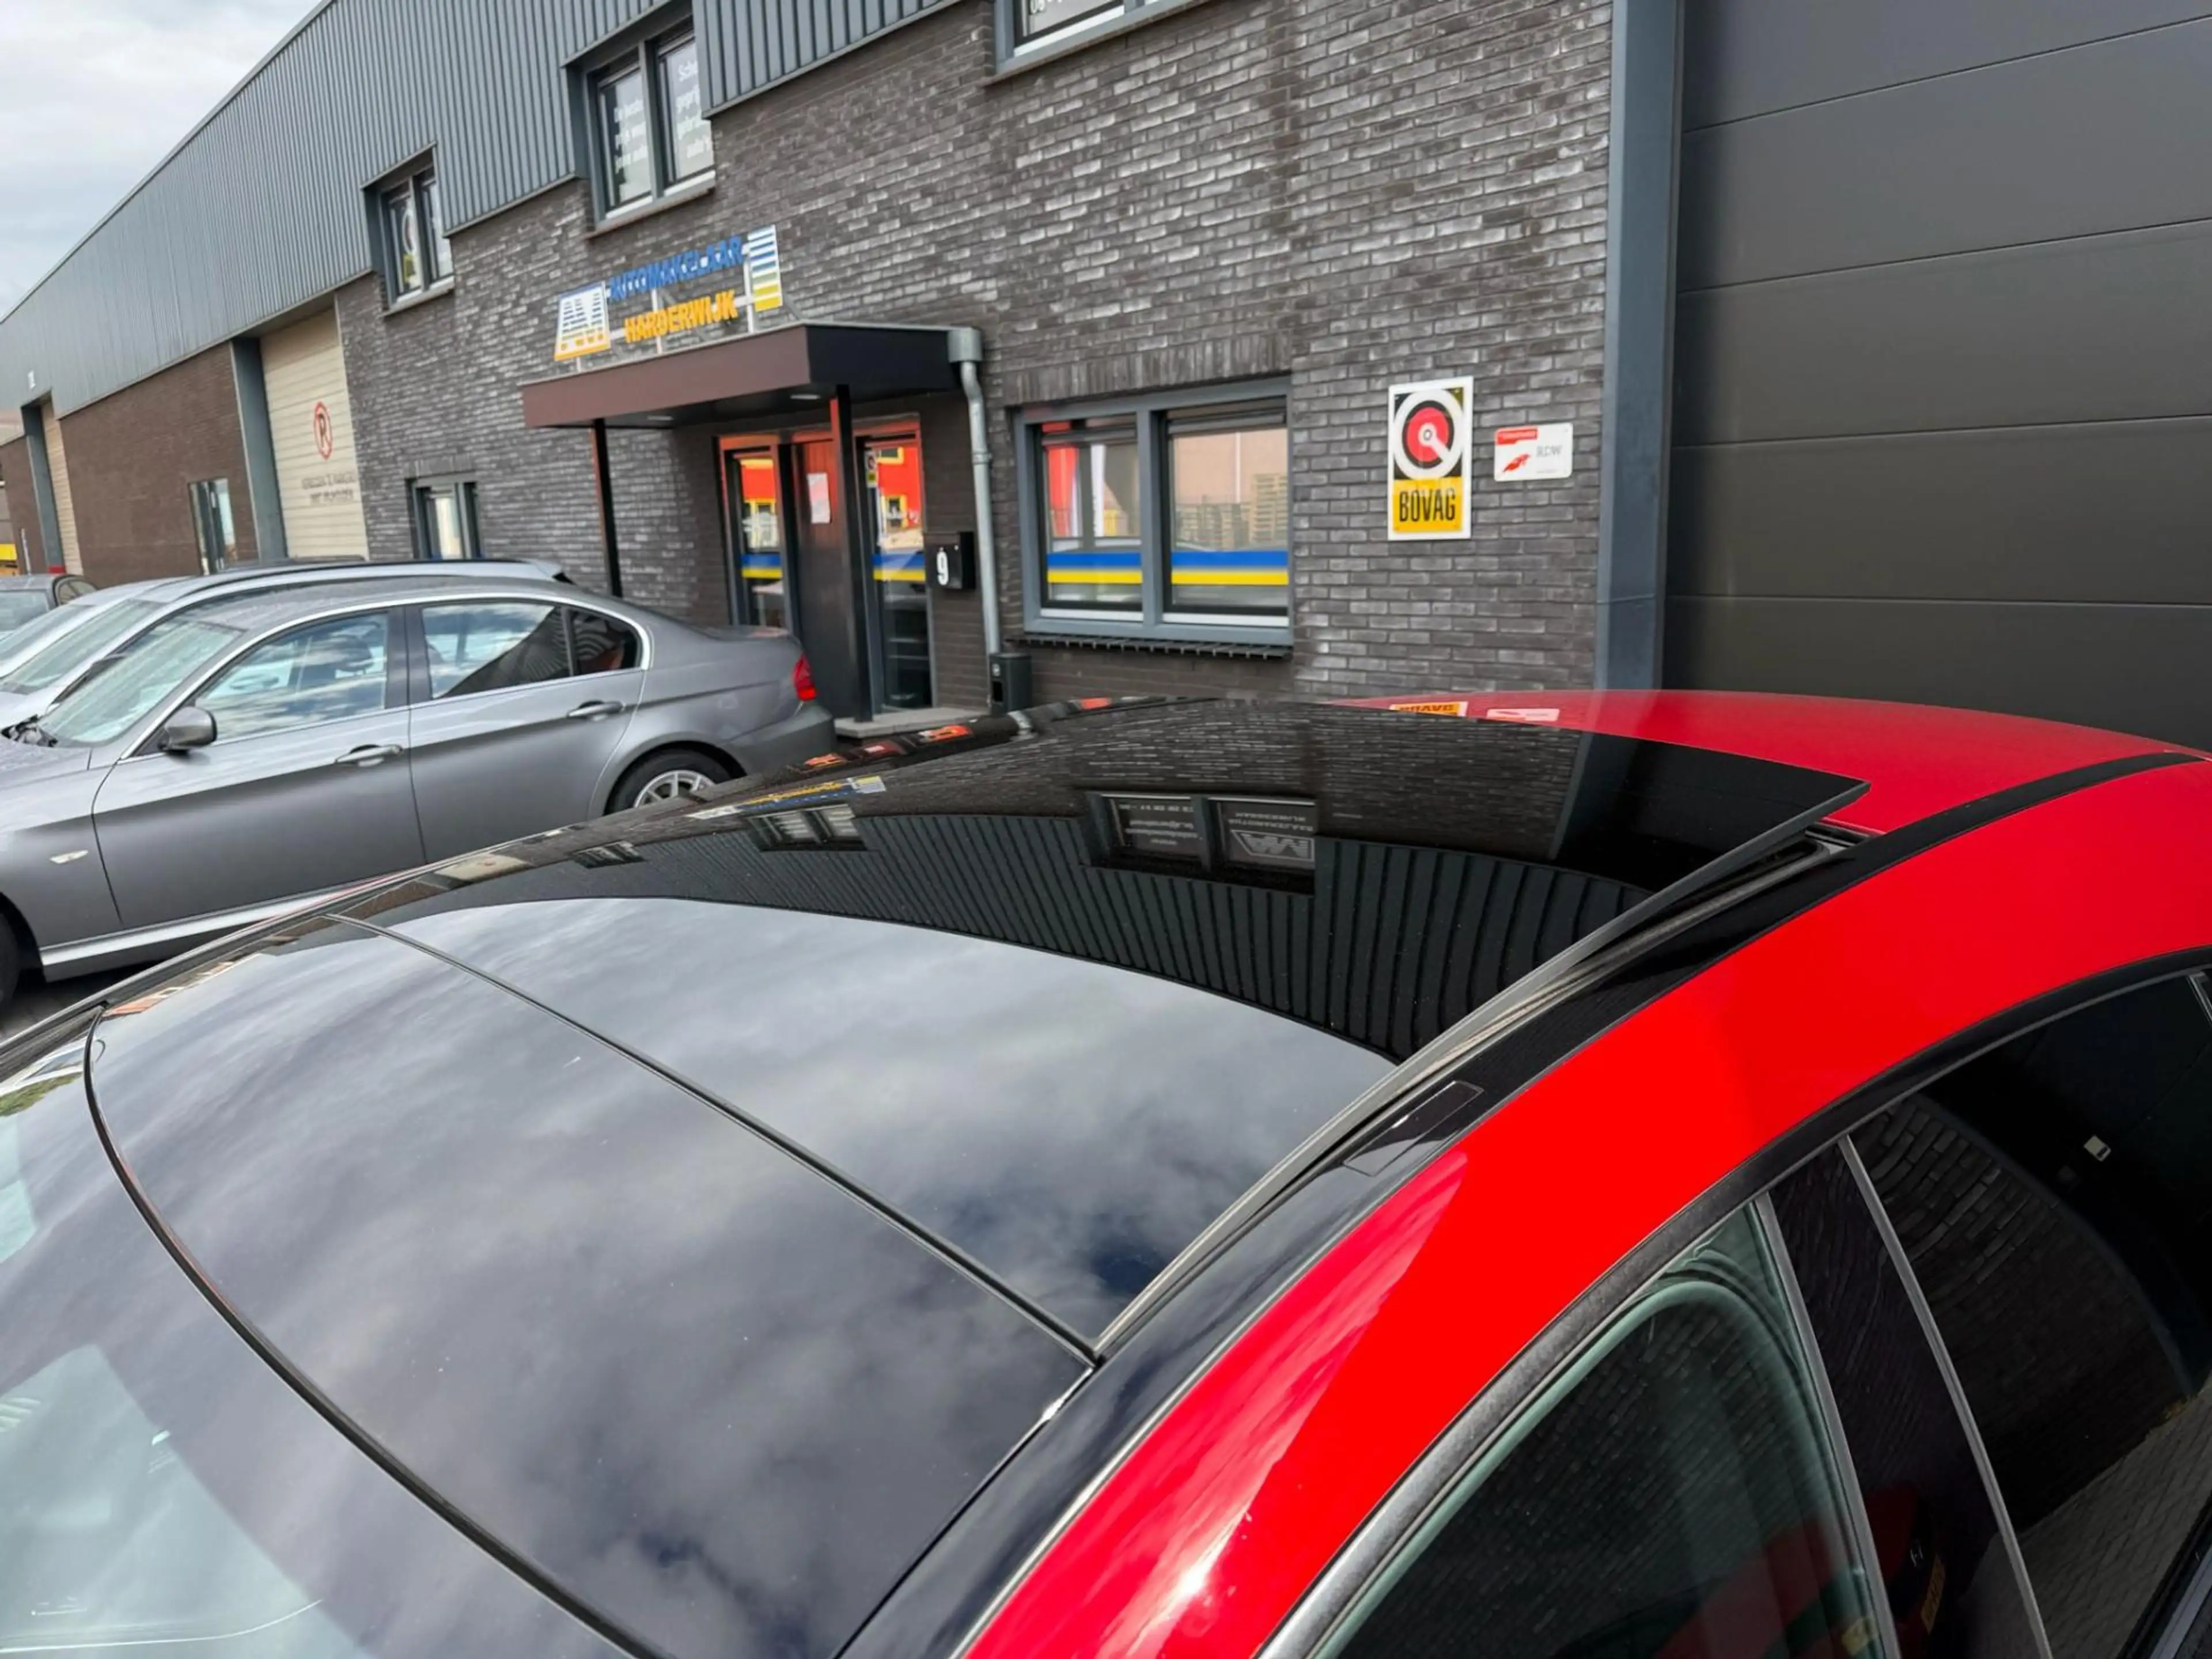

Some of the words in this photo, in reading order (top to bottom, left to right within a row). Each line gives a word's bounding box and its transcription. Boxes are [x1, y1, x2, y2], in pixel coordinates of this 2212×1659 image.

[609, 236, 744, 301] AUTOMAKELAAR
[624, 290, 738, 343] HARDERWIJK
[1399, 488, 1456, 522] BOVAG
[936, 550, 949, 585] 9
